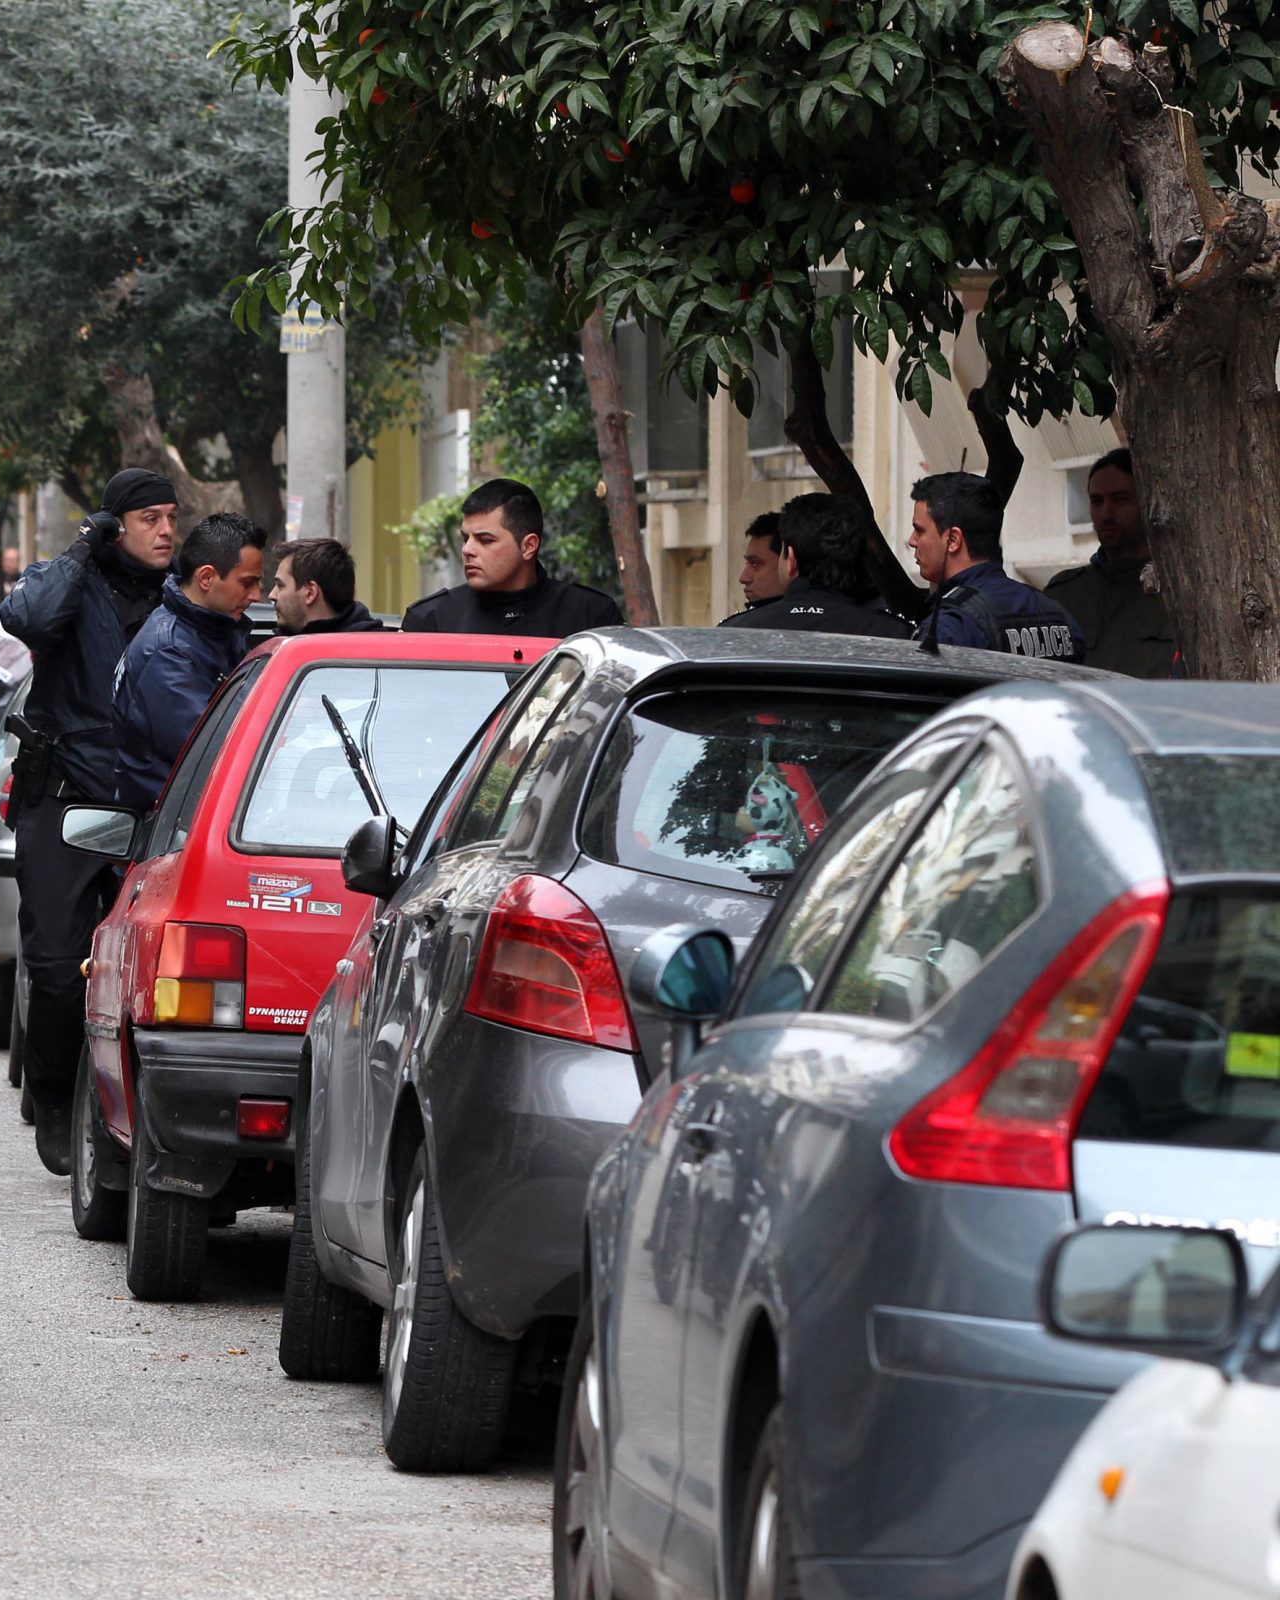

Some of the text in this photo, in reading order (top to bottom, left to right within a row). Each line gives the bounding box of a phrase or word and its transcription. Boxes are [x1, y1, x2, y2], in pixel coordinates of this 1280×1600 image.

[1005, 625, 1074, 658] POLICE
[226, 894, 338, 914] Mazda 121 LX
[248, 1006, 308, 1018] DYNAMIQUE
[273, 1016, 306, 1025] DEKAS
